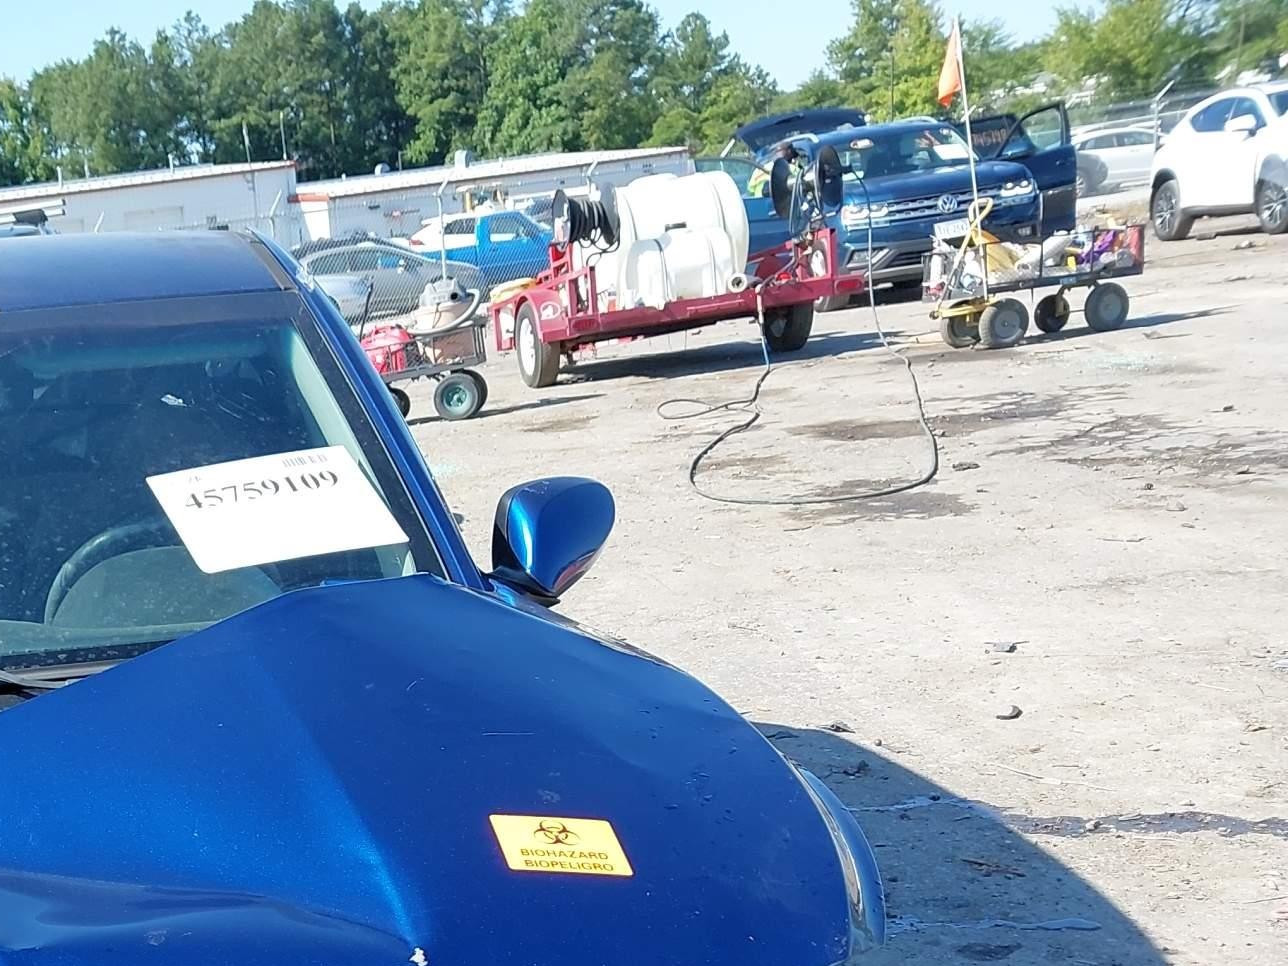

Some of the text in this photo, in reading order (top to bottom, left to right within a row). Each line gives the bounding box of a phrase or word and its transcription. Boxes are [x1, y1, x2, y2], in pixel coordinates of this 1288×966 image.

[185, 470, 338, 509] 45759109
[520, 848, 609, 860] BIOHAZARD
[524, 859, 614, 872] BIOPELIGRO
